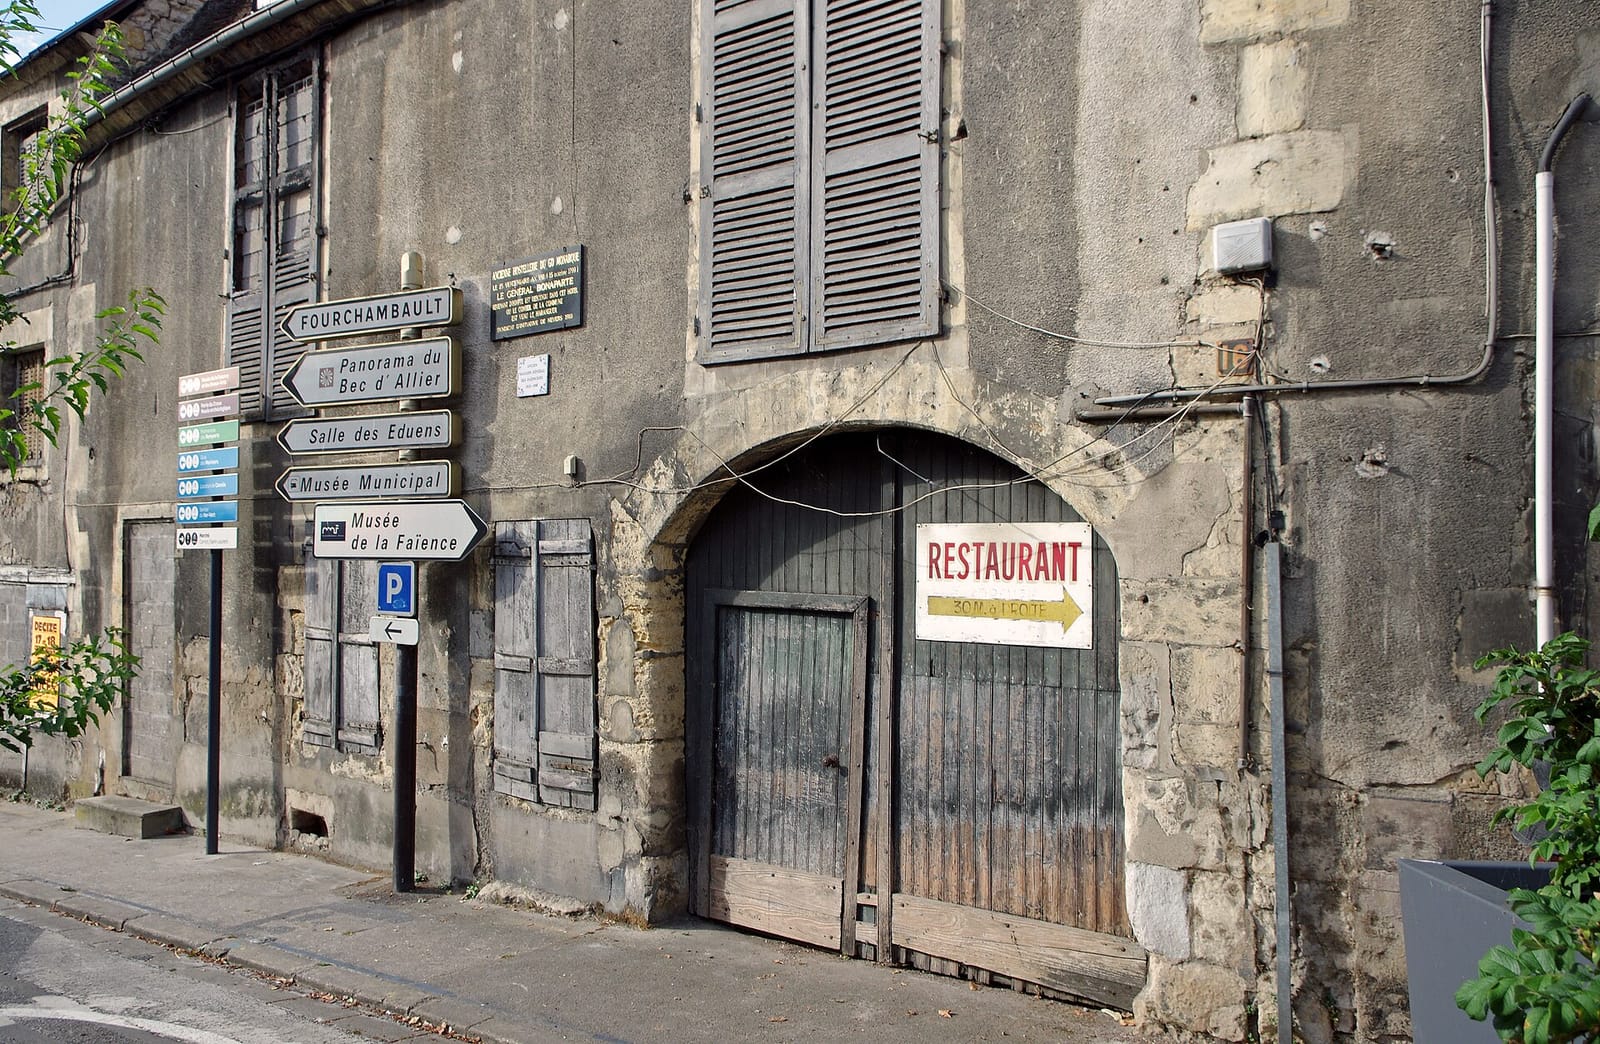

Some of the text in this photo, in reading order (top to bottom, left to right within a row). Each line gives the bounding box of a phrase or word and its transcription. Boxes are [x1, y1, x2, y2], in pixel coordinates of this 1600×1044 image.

[497, 292, 504, 301] LE
[537, 277, 574, 292] BONAPARTE
[301, 298, 442, 330] FOURCHAMBAULT
[340, 349, 441, 373] Panorama du
[340, 377, 366, 394] Bec
[309, 423, 441, 444] Salle des Eduens
[300, 471, 441, 492] Musée Municipal
[351, 512, 399, 528] Musée
[351, 533, 457, 550] de la Faïence
[928, 542, 1082, 582] RESTAURANT
[386, 573, 403, 604] P
[35, 621, 57, 633] DECIZE
